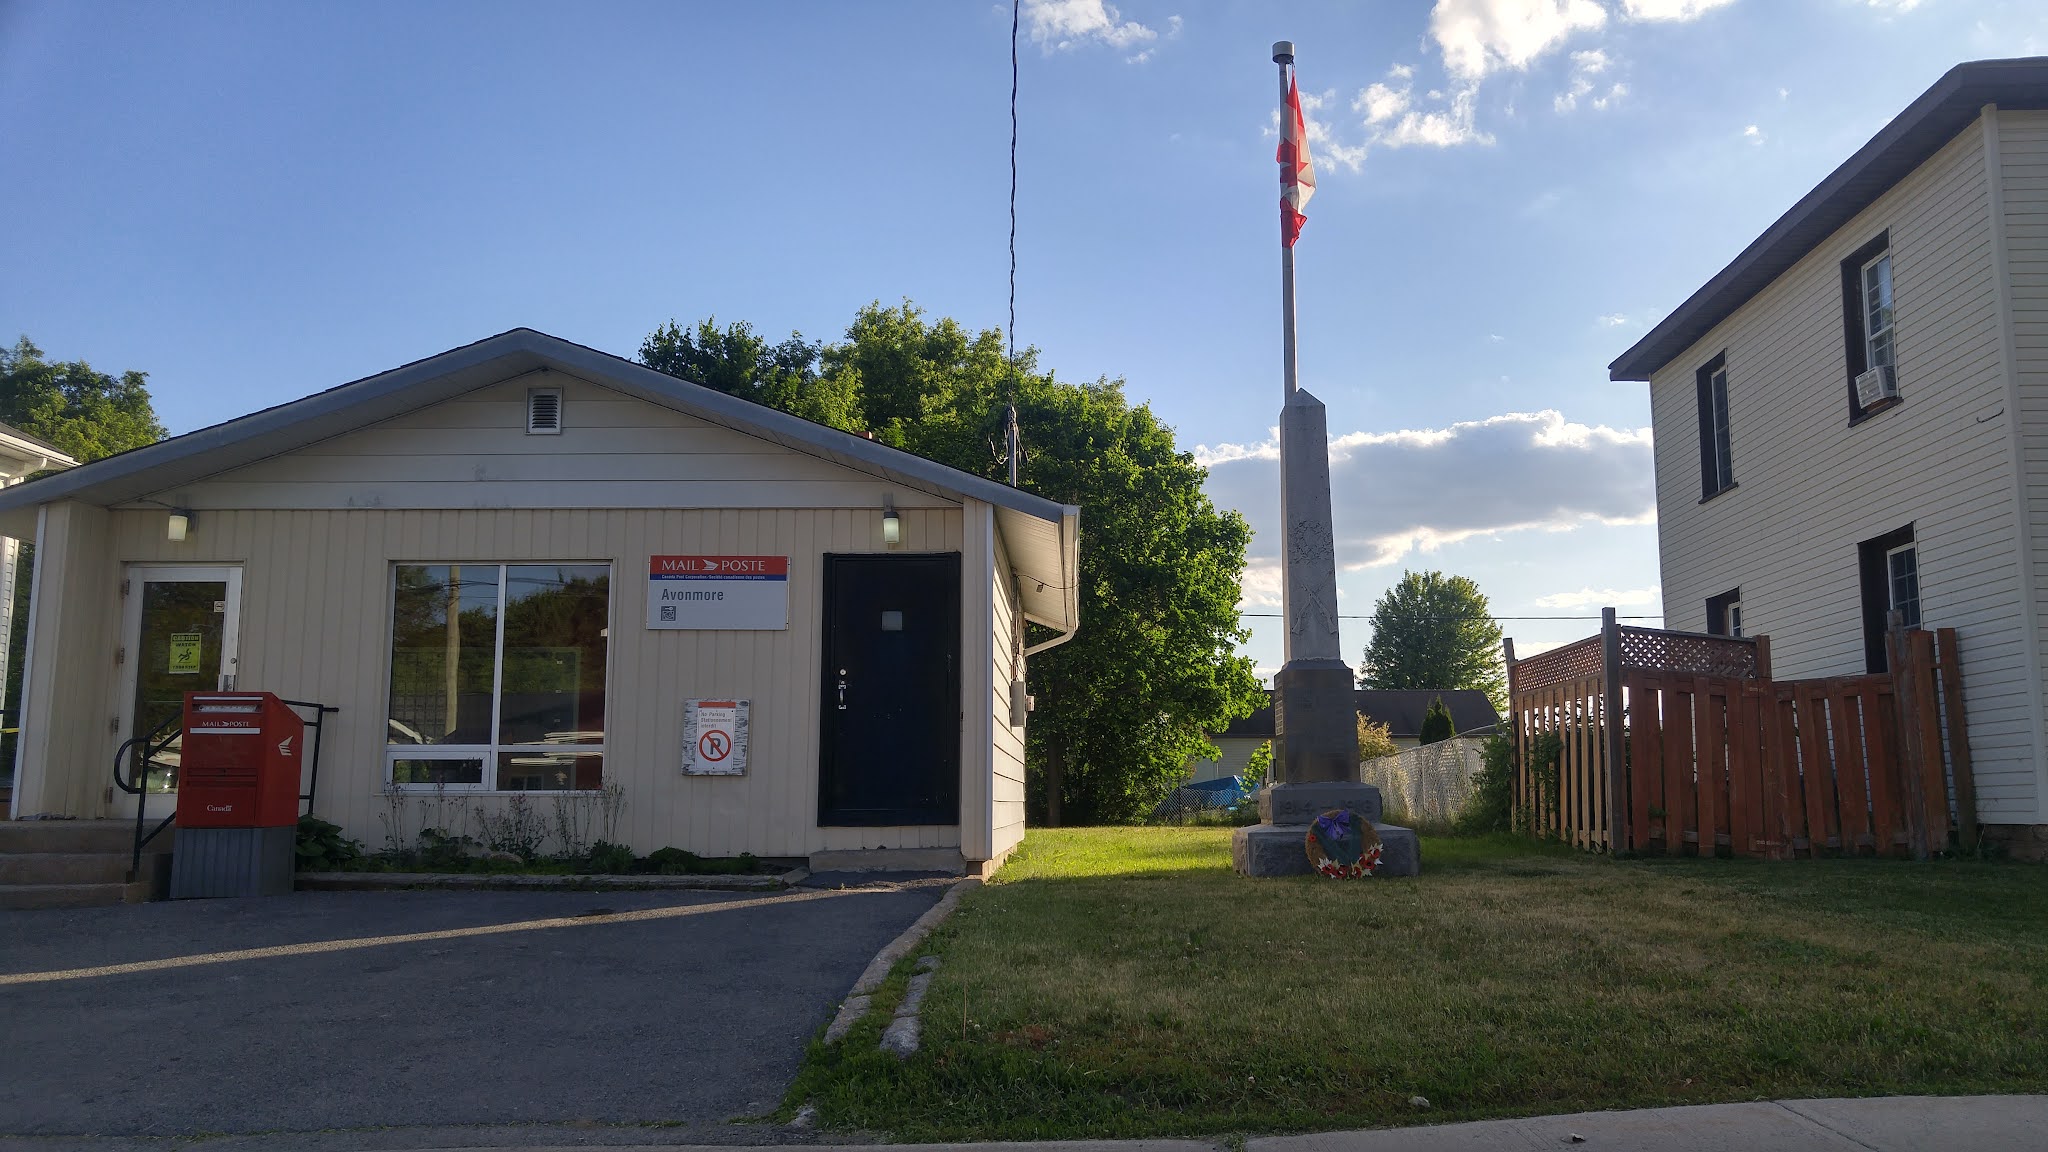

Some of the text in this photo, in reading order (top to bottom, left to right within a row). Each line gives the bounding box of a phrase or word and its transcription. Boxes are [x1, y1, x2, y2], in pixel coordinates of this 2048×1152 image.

[661, 559, 766, 572] MAIL POSTE
[661, 588, 724, 601] Avonmore
[206, 804, 233, 812] Canada
[1278, 799, 1313, 816] 1914
